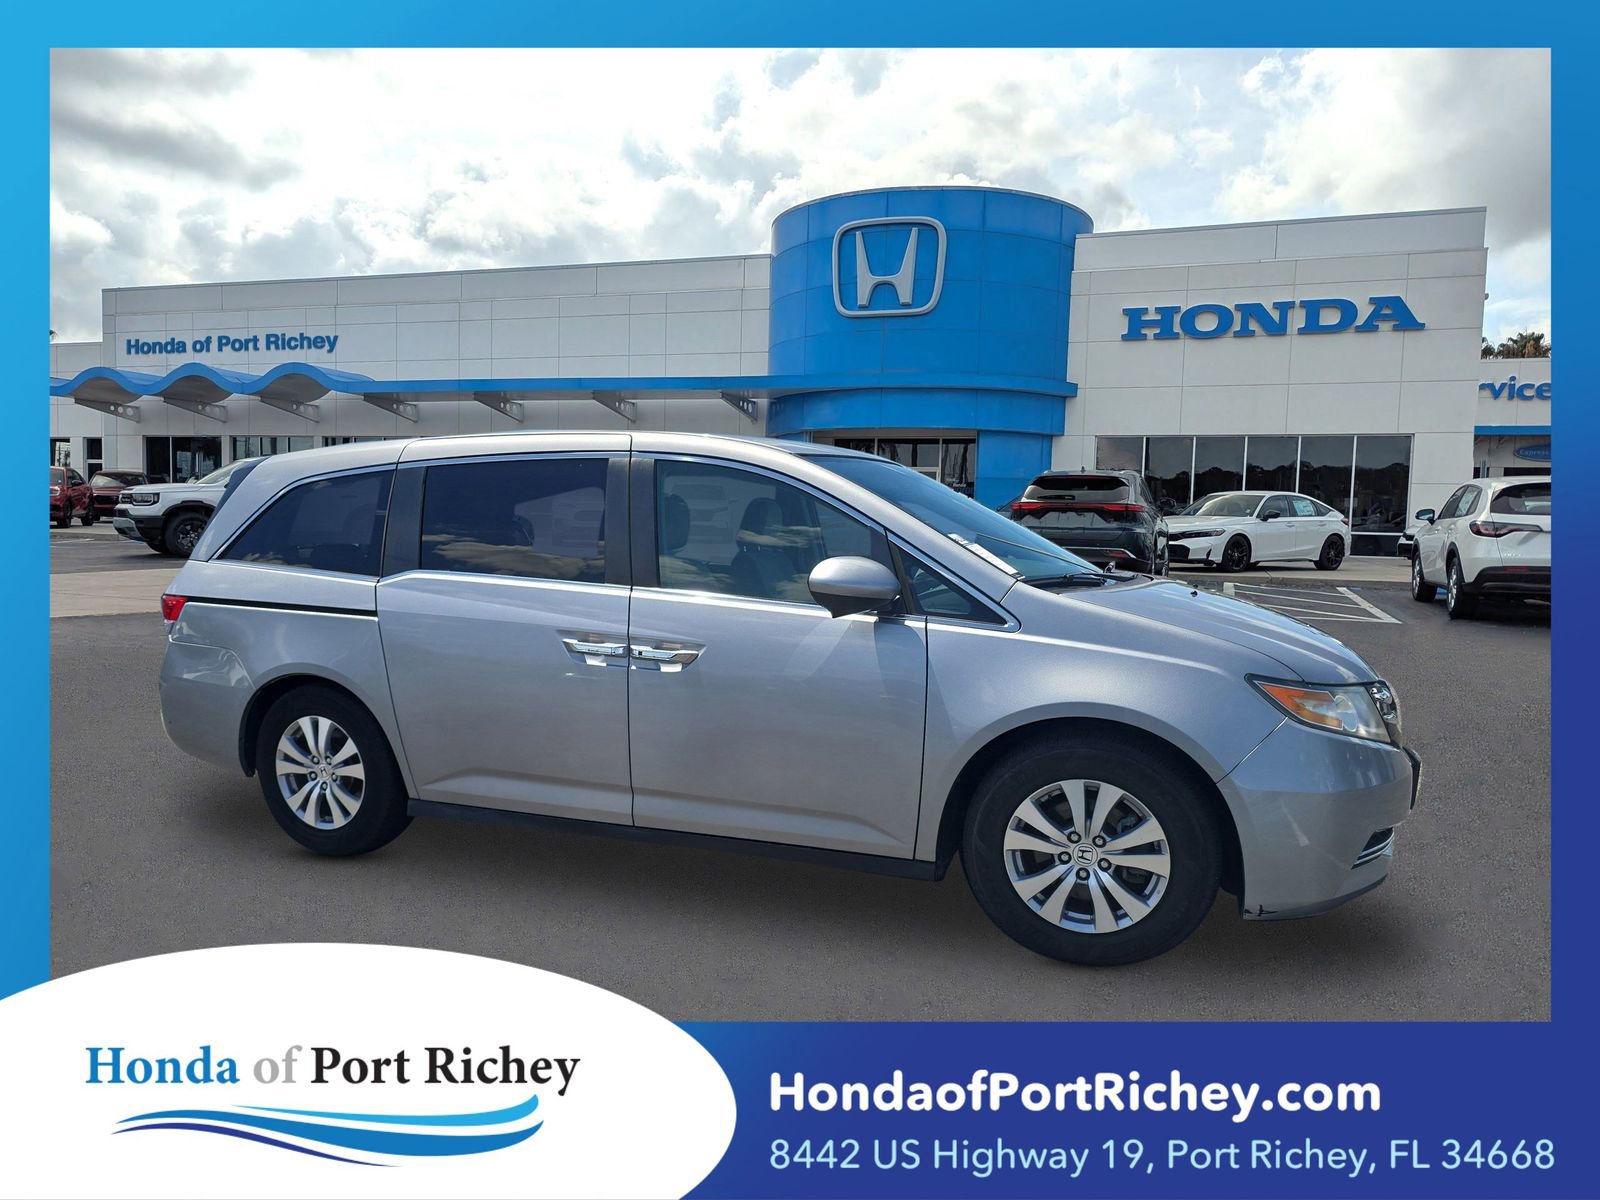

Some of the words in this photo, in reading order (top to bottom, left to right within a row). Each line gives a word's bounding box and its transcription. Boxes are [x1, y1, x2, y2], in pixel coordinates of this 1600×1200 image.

[1121, 295, 1426, 340] HONDA
[126, 338, 187, 355] Honda
[191, 336, 212, 353] of
[217, 335, 258, 352] Port
[265, 333, 338, 353] Richey
